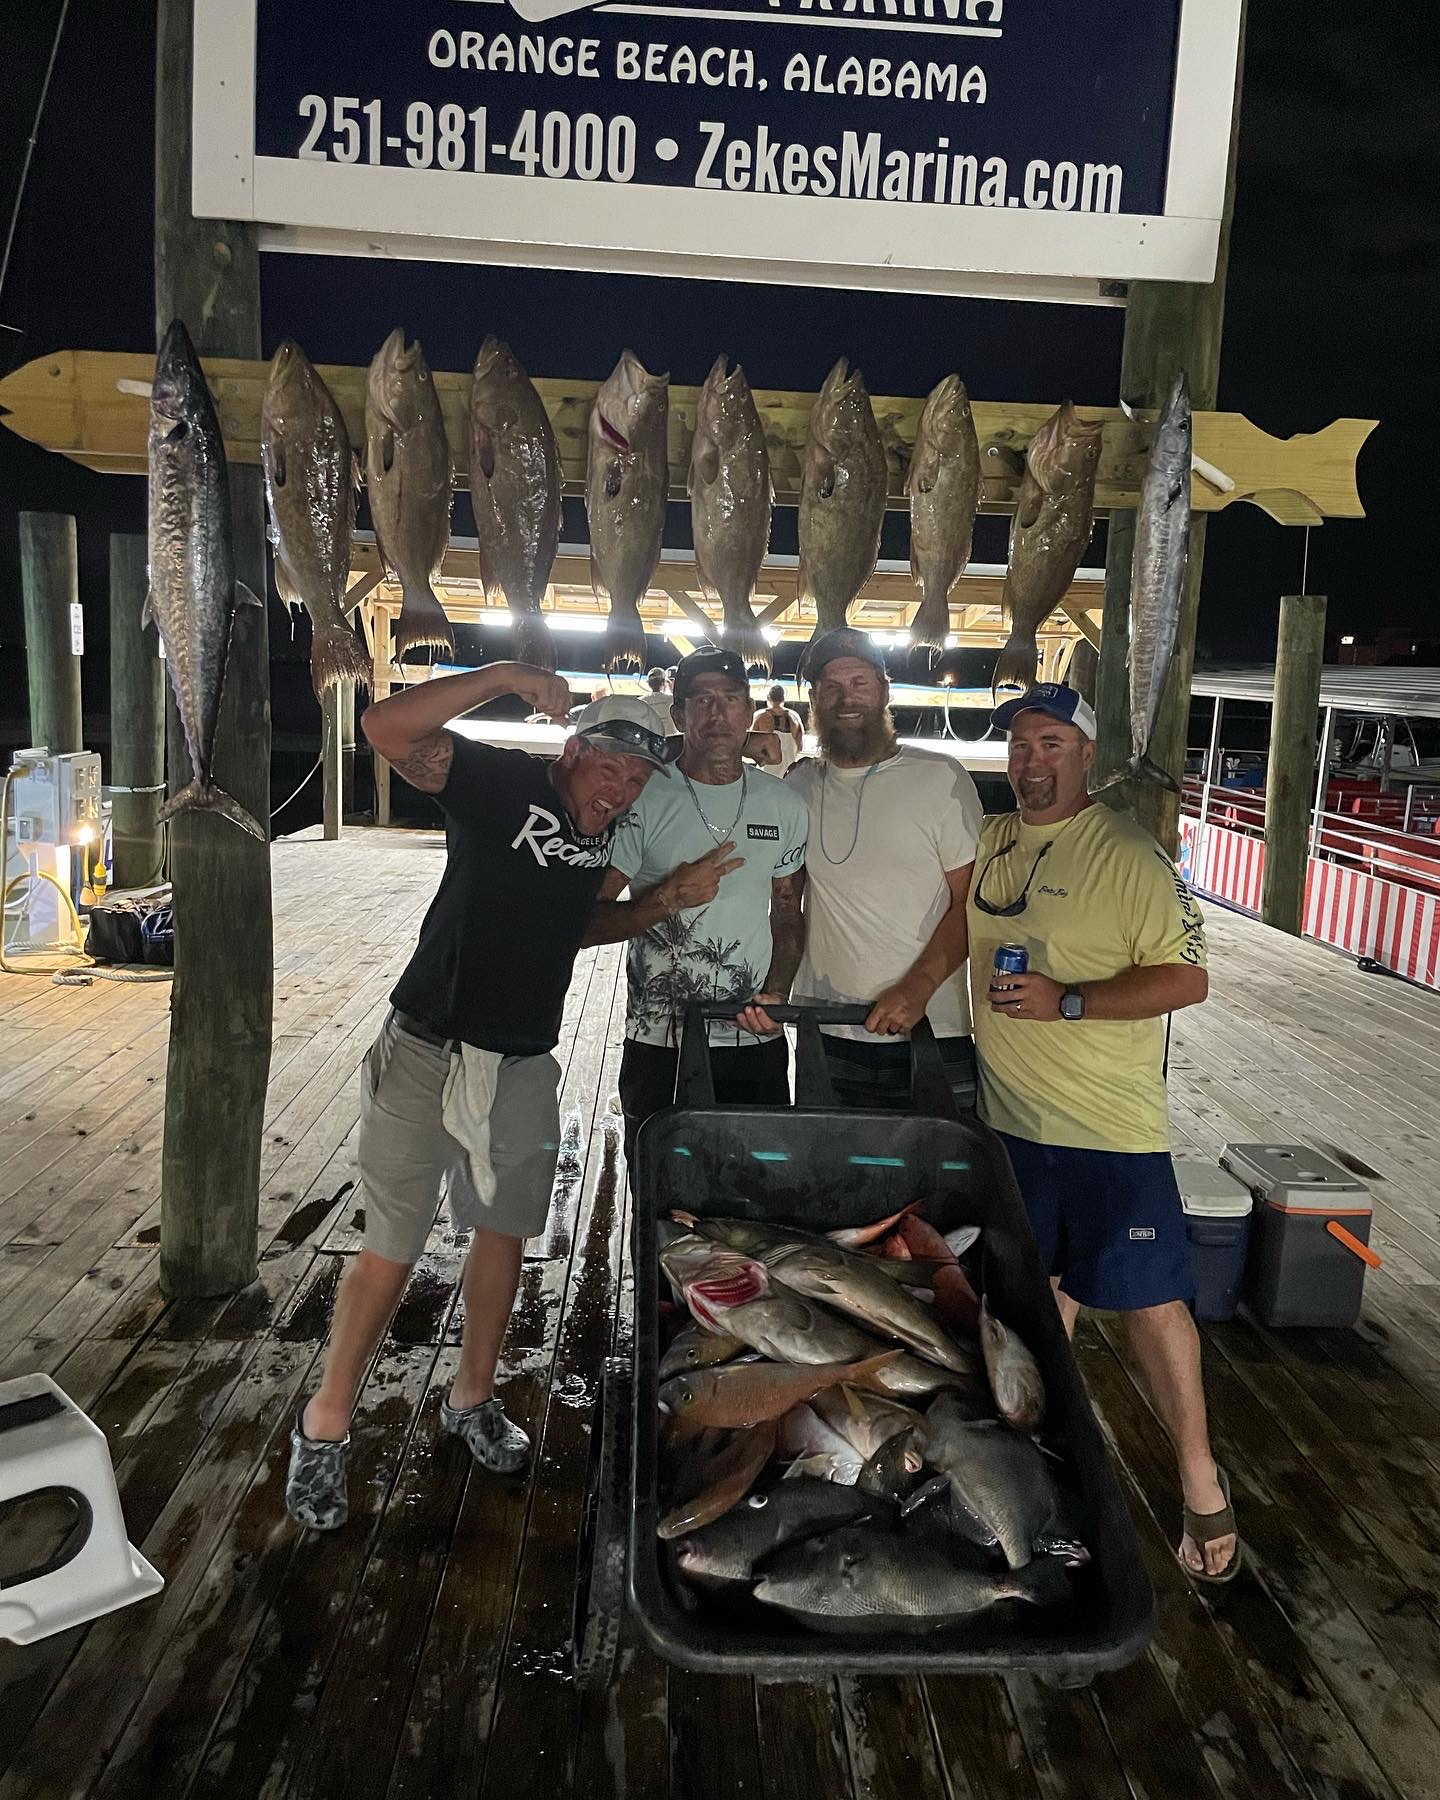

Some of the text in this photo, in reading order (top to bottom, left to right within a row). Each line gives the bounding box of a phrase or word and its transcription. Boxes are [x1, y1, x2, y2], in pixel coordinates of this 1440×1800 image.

[428, 29, 988, 104] ORANGE BEACH, ALABAMA
[299, 94, 1123, 214] 251-981-4000 ZekesMarina.com
[748, 827, 778, 838] SAVAGE
